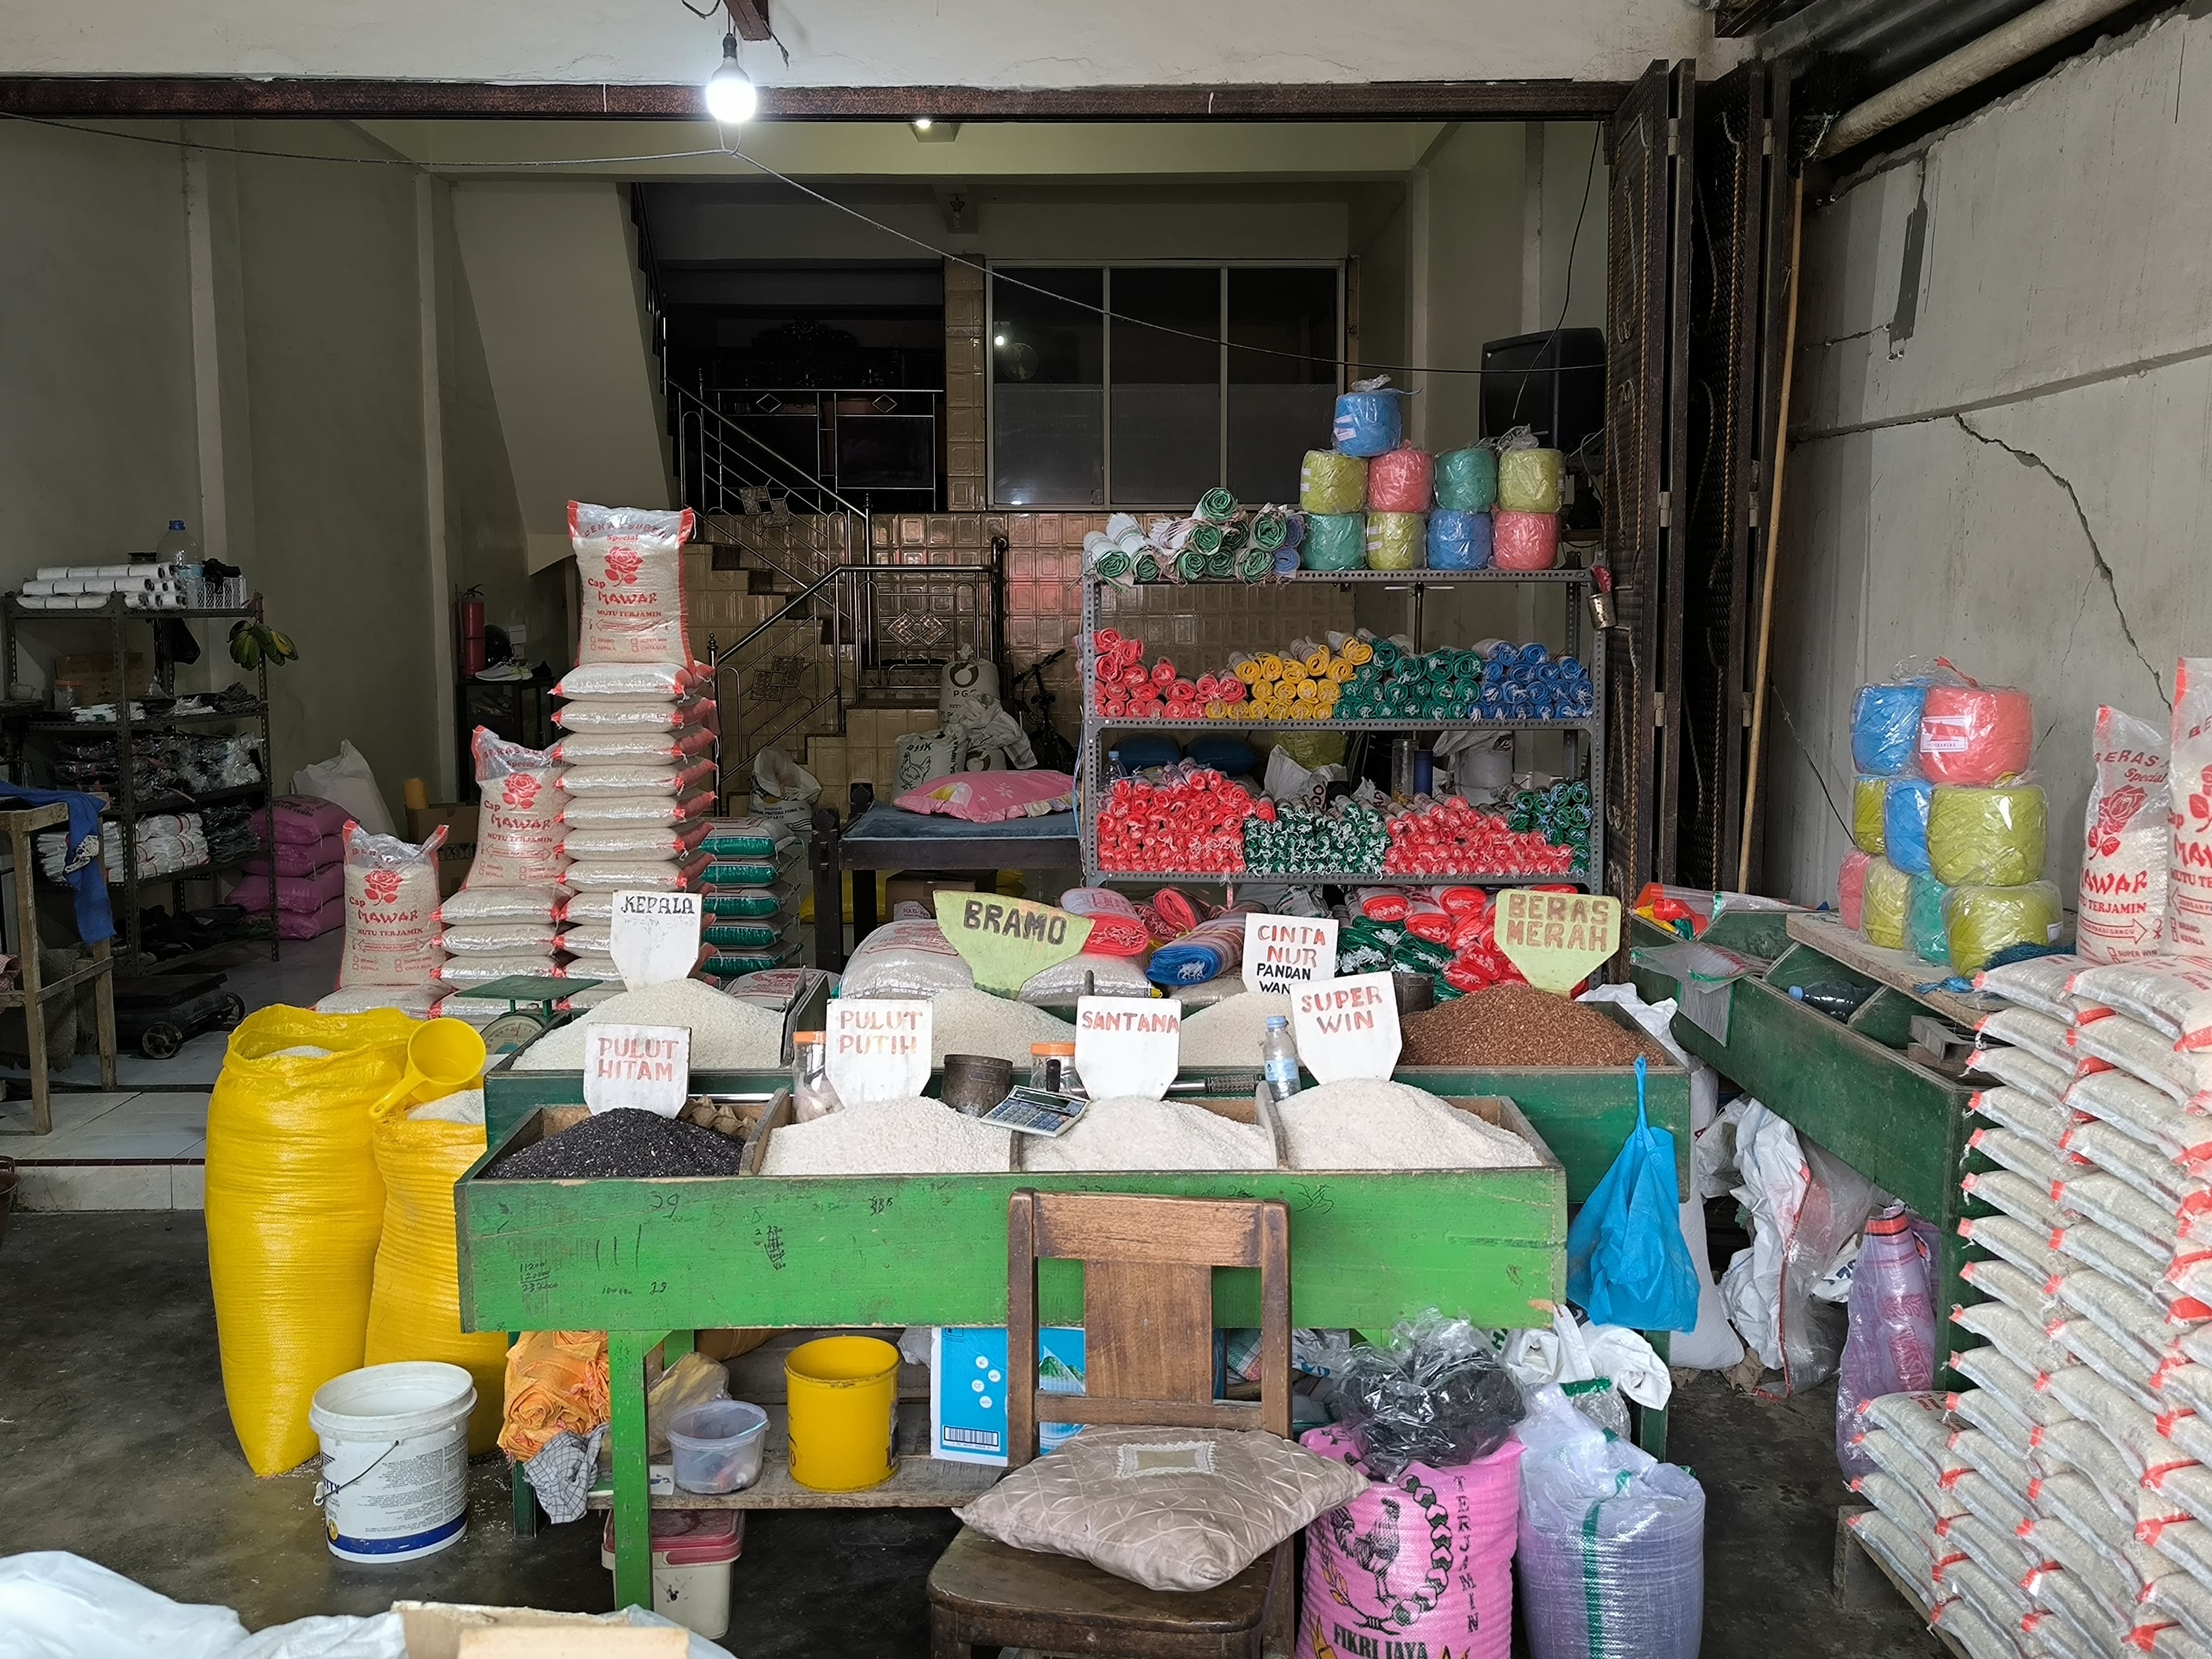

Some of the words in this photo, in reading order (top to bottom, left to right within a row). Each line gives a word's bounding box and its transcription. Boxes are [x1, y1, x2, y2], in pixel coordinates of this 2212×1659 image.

[588, 578, 605, 589] Cap
[598, 591, 657, 605] MAWAR
[2124, 768, 2168, 783] Special
[484, 800, 501, 812] Cap
[491, 814, 551, 830] MAWAR
[488, 833, 508, 841] MUTU
[2082, 867, 2147, 896] AWAR
[2170, 868, 2196, 885] MUTU
[2200, 874, 2212, 888] TE
[349, 896, 366, 907] Cap
[621, 895, 695, 914] KEPALA
[1508, 893, 1609, 925] BERAS
[2088, 899, 2147, 914] TERJAMIN
[358, 909, 419, 924] MAWAR
[963, 899, 1067, 945] BRAMO
[380, 928, 423, 936] TERJAMIN
[1257, 925, 1326, 946] CINTA
[1506, 919, 1608, 952] MERAH
[1267, 945, 1318, 968] NUR
[1256, 962, 1312, 981] PANDAN
[1259, 980, 1290, 995] WAN
[1301, 986, 1383, 1013] SUPER
[840, 1010, 923, 1030] PULUT
[1082, 1010, 1180, 1034] SANTANA
[1316, 1010, 1374, 1035] WIN
[597, 1037, 679, 1060] PULUT
[839, 1034, 917, 1055] PUTIH
[597, 1058, 673, 1082] HITAM
[1453, 1475, 1479, 1633] TERJAMIN
[1333, 1622, 1379, 1659] FIKRI
